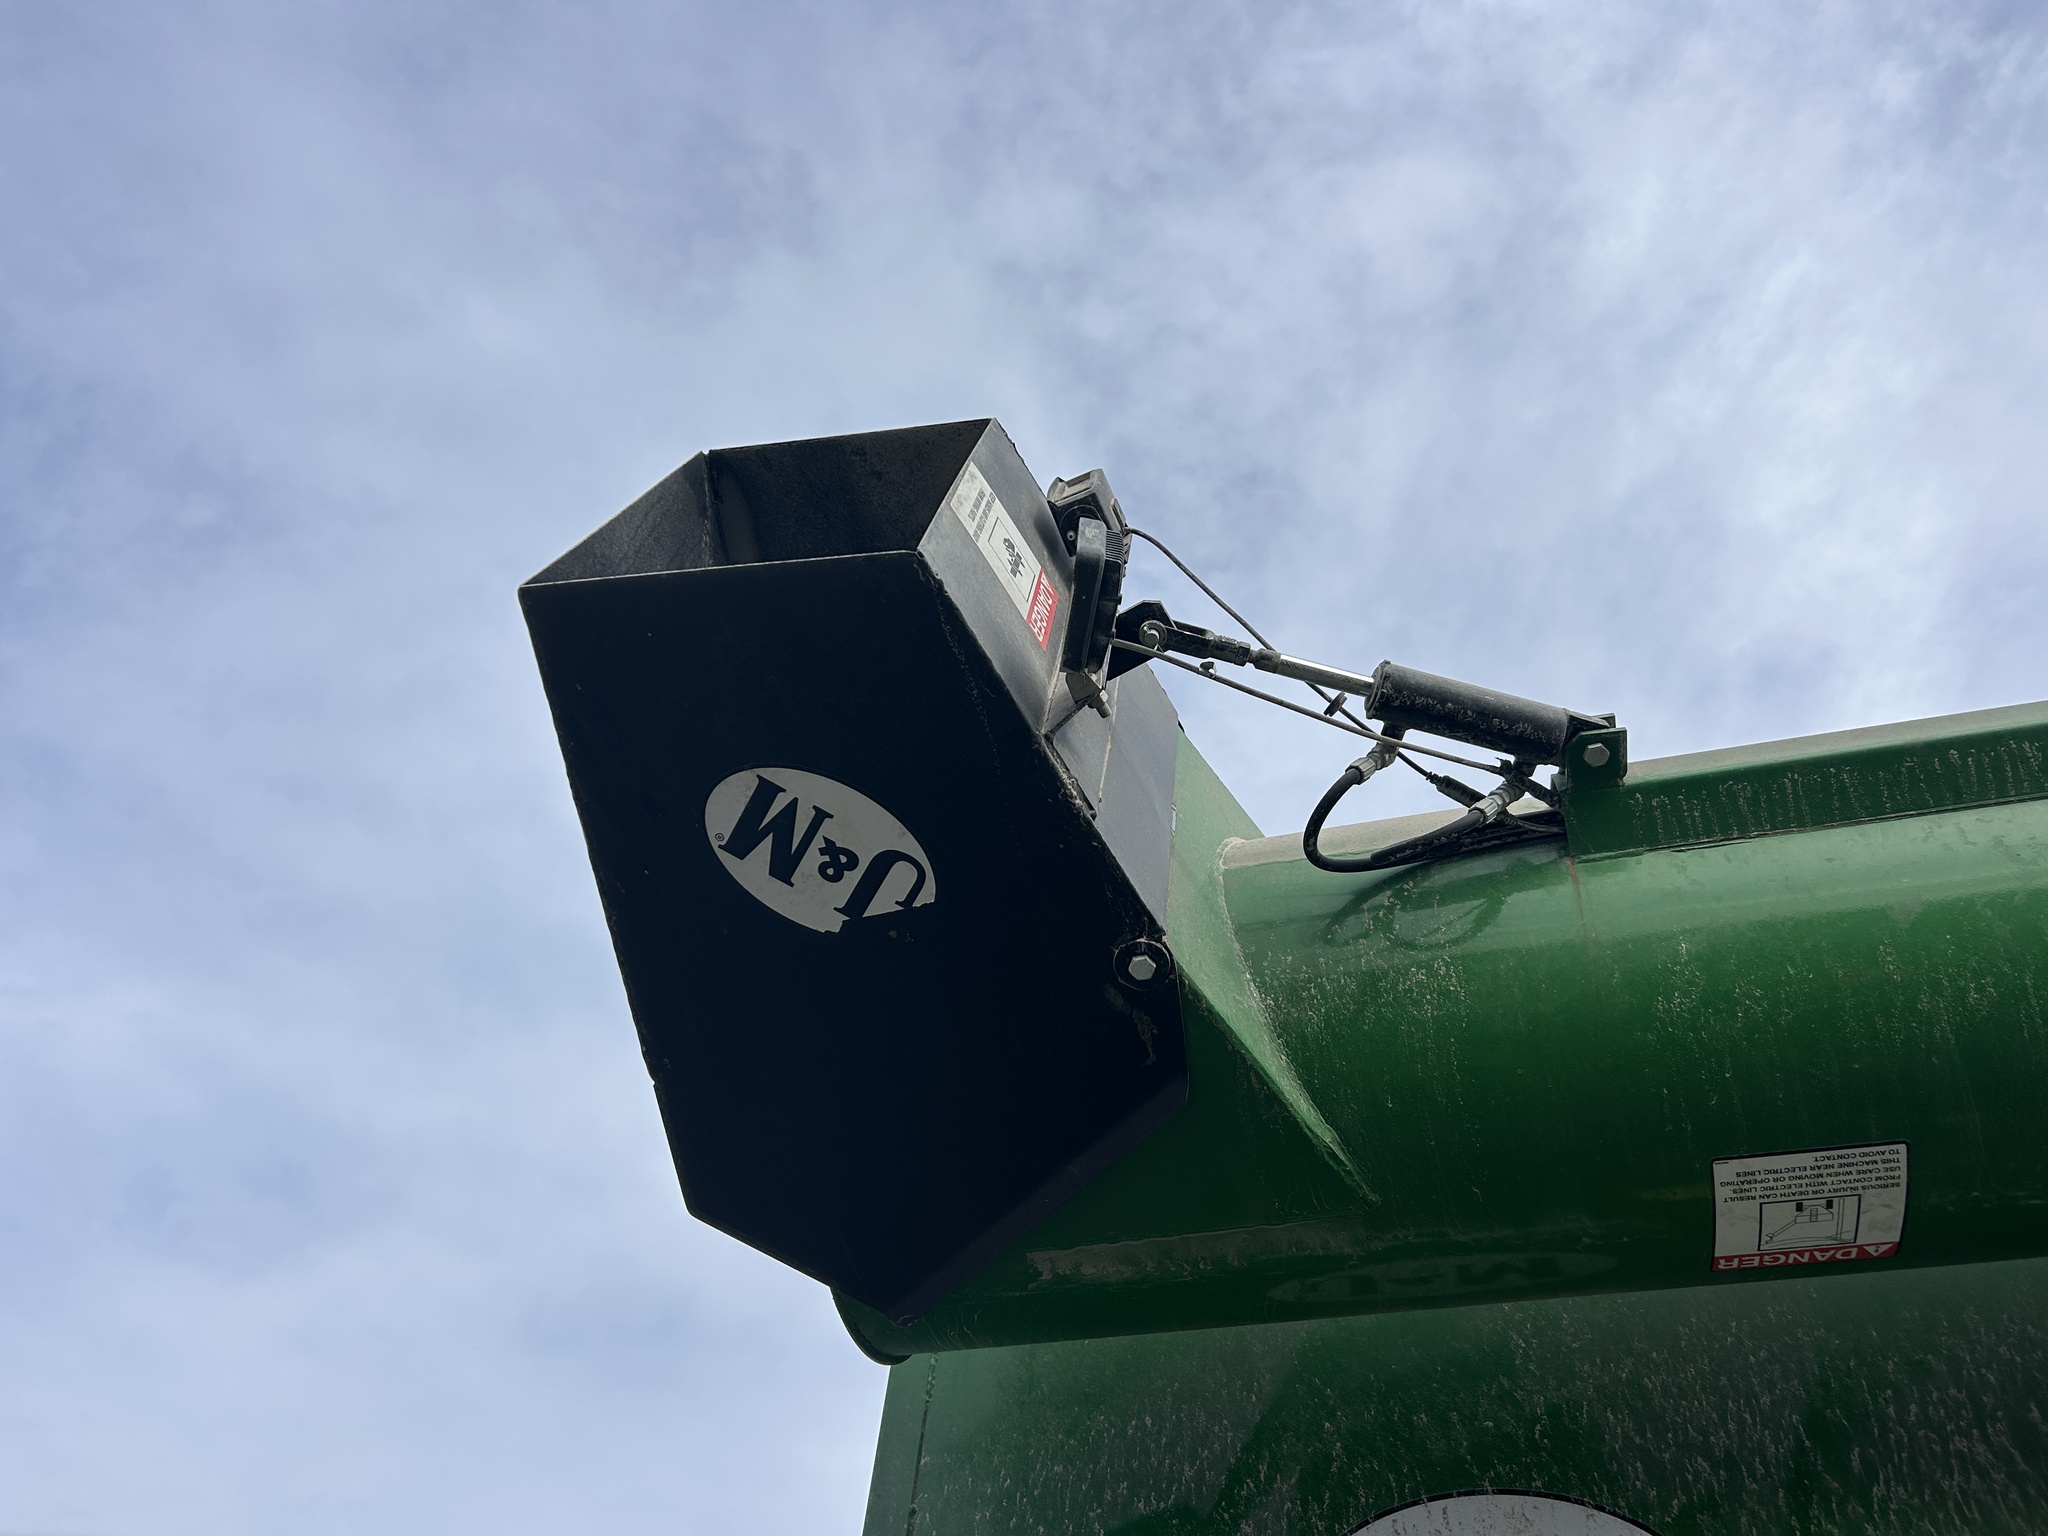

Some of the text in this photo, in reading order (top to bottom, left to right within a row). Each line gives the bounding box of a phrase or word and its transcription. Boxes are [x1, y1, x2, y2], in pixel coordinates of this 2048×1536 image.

[1030, 584, 1053, 642] DANGER
[718, 774, 926, 919] J&M
[1812, 1152, 1856, 1162] CONTACT.
[1858, 1150, 1886, 1158] AVOID
[1809, 1163, 1834, 1171] NEAR
[1837, 1159, 1878, 1168] MACHINE
[1735, 1169, 1761, 1178] LINES
[1764, 1166, 1807, 1175] ELECTRIC
[1826, 1170, 1853, 1178] WHEN
[1720, 1177, 1771, 1187] OPERATING
[1805, 1180, 1828, 1188] WITH
[1831, 1177, 1872, 1185] CONTACT
[1730, 1186, 1758, 1194] LINES.
[1759, 1182, 1803, 1192] ELECTRIC
[1861, 1182, 1901, 1190] SERIOUS
[1780, 1190, 1809, 1198] DEATH
[1723, 1195, 1756, 1203] RESULT
[1718, 1248, 1859, 1270] DANGER
